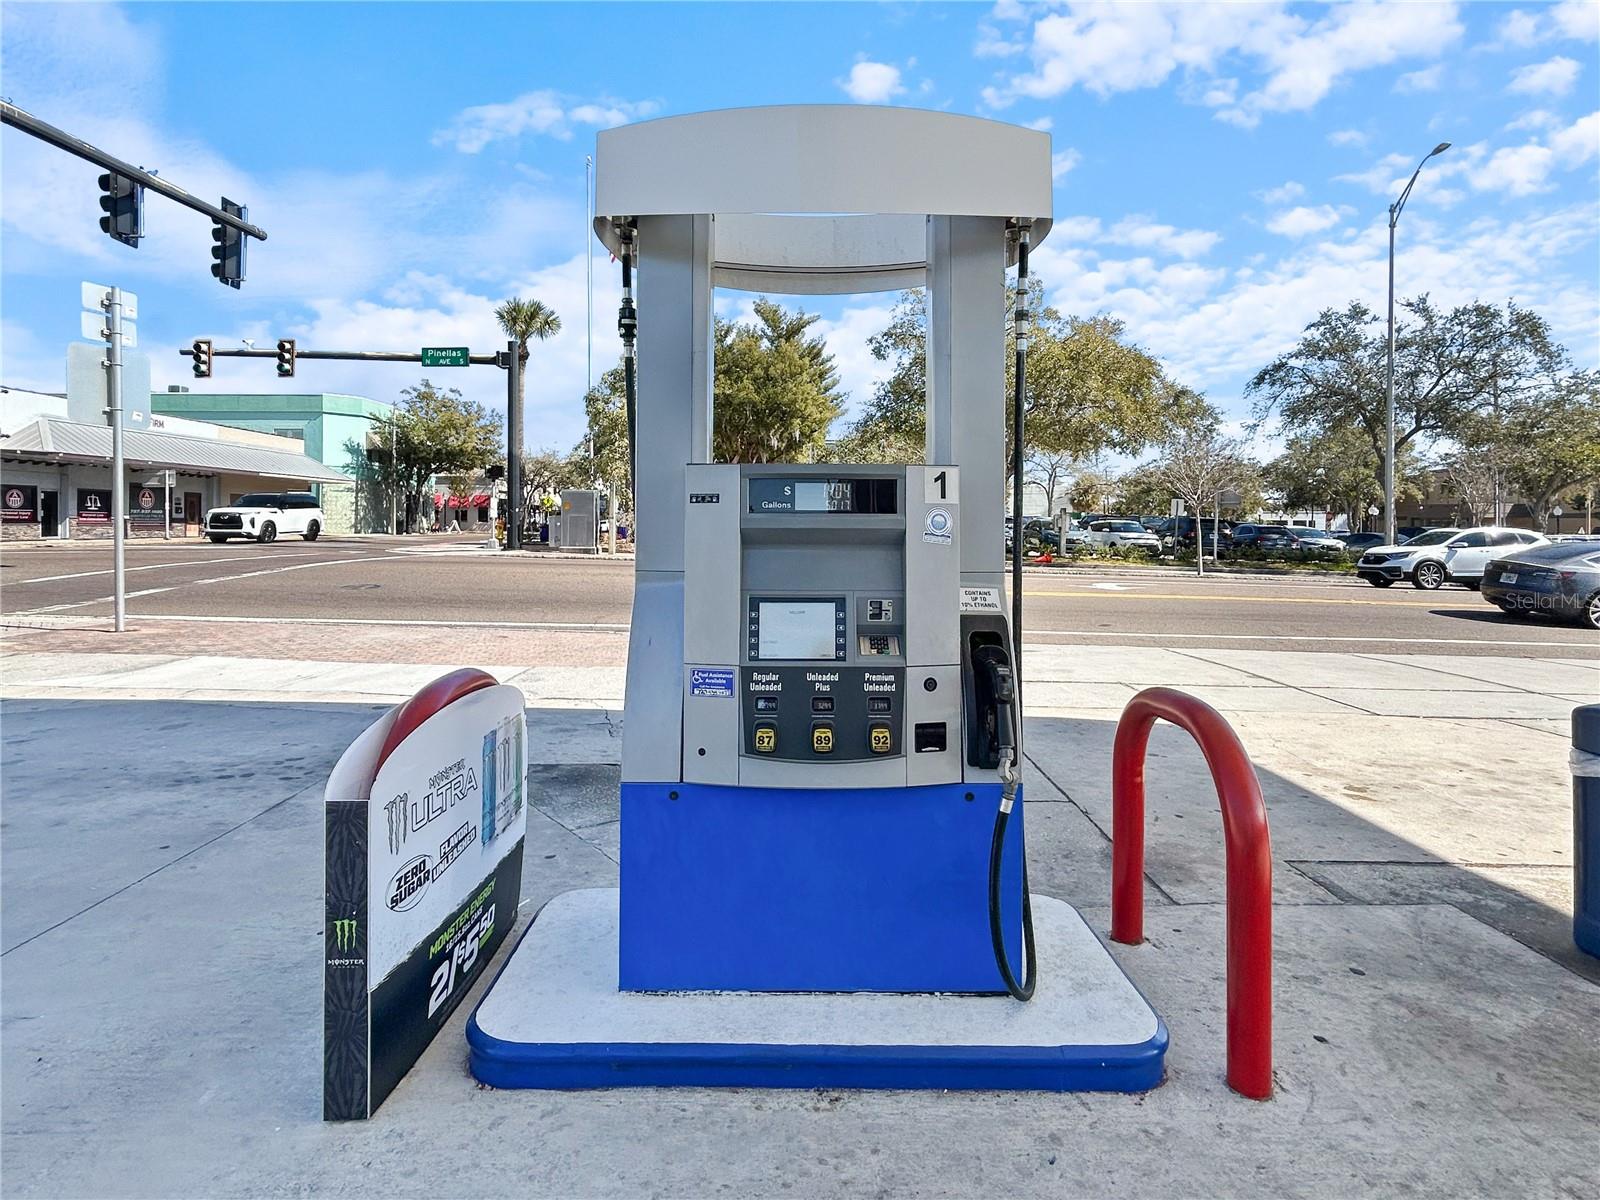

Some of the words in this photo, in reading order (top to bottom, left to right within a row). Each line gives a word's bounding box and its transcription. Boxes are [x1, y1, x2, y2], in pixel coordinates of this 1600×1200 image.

[427, 349, 462, 357] Pinellas
[934, 471, 946, 500] 1
[761, 501, 792, 509] Gallons
[752, 672, 780, 682] Regular
[806, 672, 839, 682] Unleaded
[864, 672, 895, 682] Premium
[749, 683, 782, 692] Unleaded
[815, 683, 831, 692] Plus
[863, 683, 896, 692] Unleaded
[757, 735, 773, 745] 87
[815, 735, 831, 745] 89
[873, 735, 889, 745] 92
[428, 758, 465, 789] MONSTER
[411, 767, 478, 832] ULTRA
[440, 822, 469, 857] FLAVOR
[432, 829, 475, 879] UNLEASHED
[395, 859, 426, 892] ZERO
[390, 868, 431, 910] SUGAR
[429, 907, 471, 960] MONSTER
[469, 877, 497, 917] ENERGY
[327, 958, 365, 966] MONSTER
